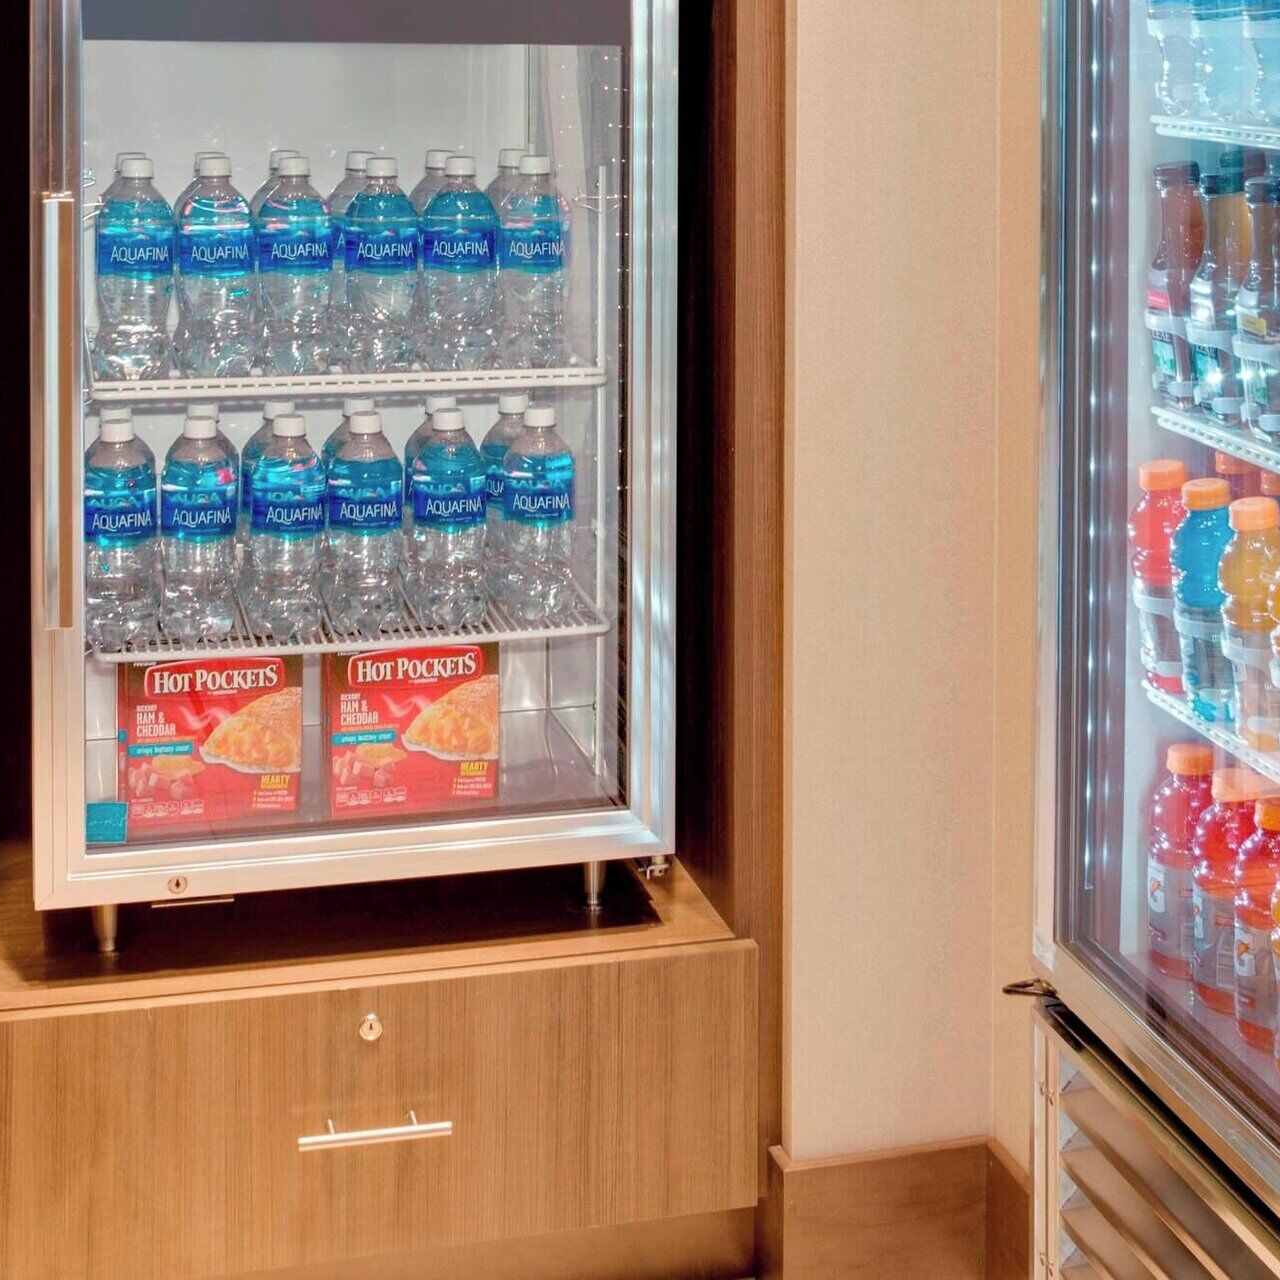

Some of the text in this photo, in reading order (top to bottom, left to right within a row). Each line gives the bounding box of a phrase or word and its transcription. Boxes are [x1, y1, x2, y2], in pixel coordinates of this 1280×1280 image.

[111, 245, 170, 264] AQUAFINA
[190, 244, 250, 263] AQUAFINA
[271, 241, 329, 261] AQUAFINA
[357, 241, 416, 262] AQUAFINA
[432, 238, 490, 258] AQUAFINA
[508, 239, 566, 259] AQUAFINA
[339, 499, 398, 520] AQUAFINA
[426, 496, 483, 516] AQUAFINA
[513, 492, 571, 514] AQUAFINA
[91, 509, 153, 531] AQUAFINA
[172, 507, 232, 527] AQUAFINA
[266, 504, 322, 524] AQUAFINA
[356, 652, 477, 683] HOT POCKETS
[153, 664, 279, 695] HOT POCKETS
[340, 700, 368, 713] HAM &
[136, 712, 165, 725] HAM &
[340, 712, 379, 726] CHEDDAR
[136, 724, 176, 737] CHEDDAR
